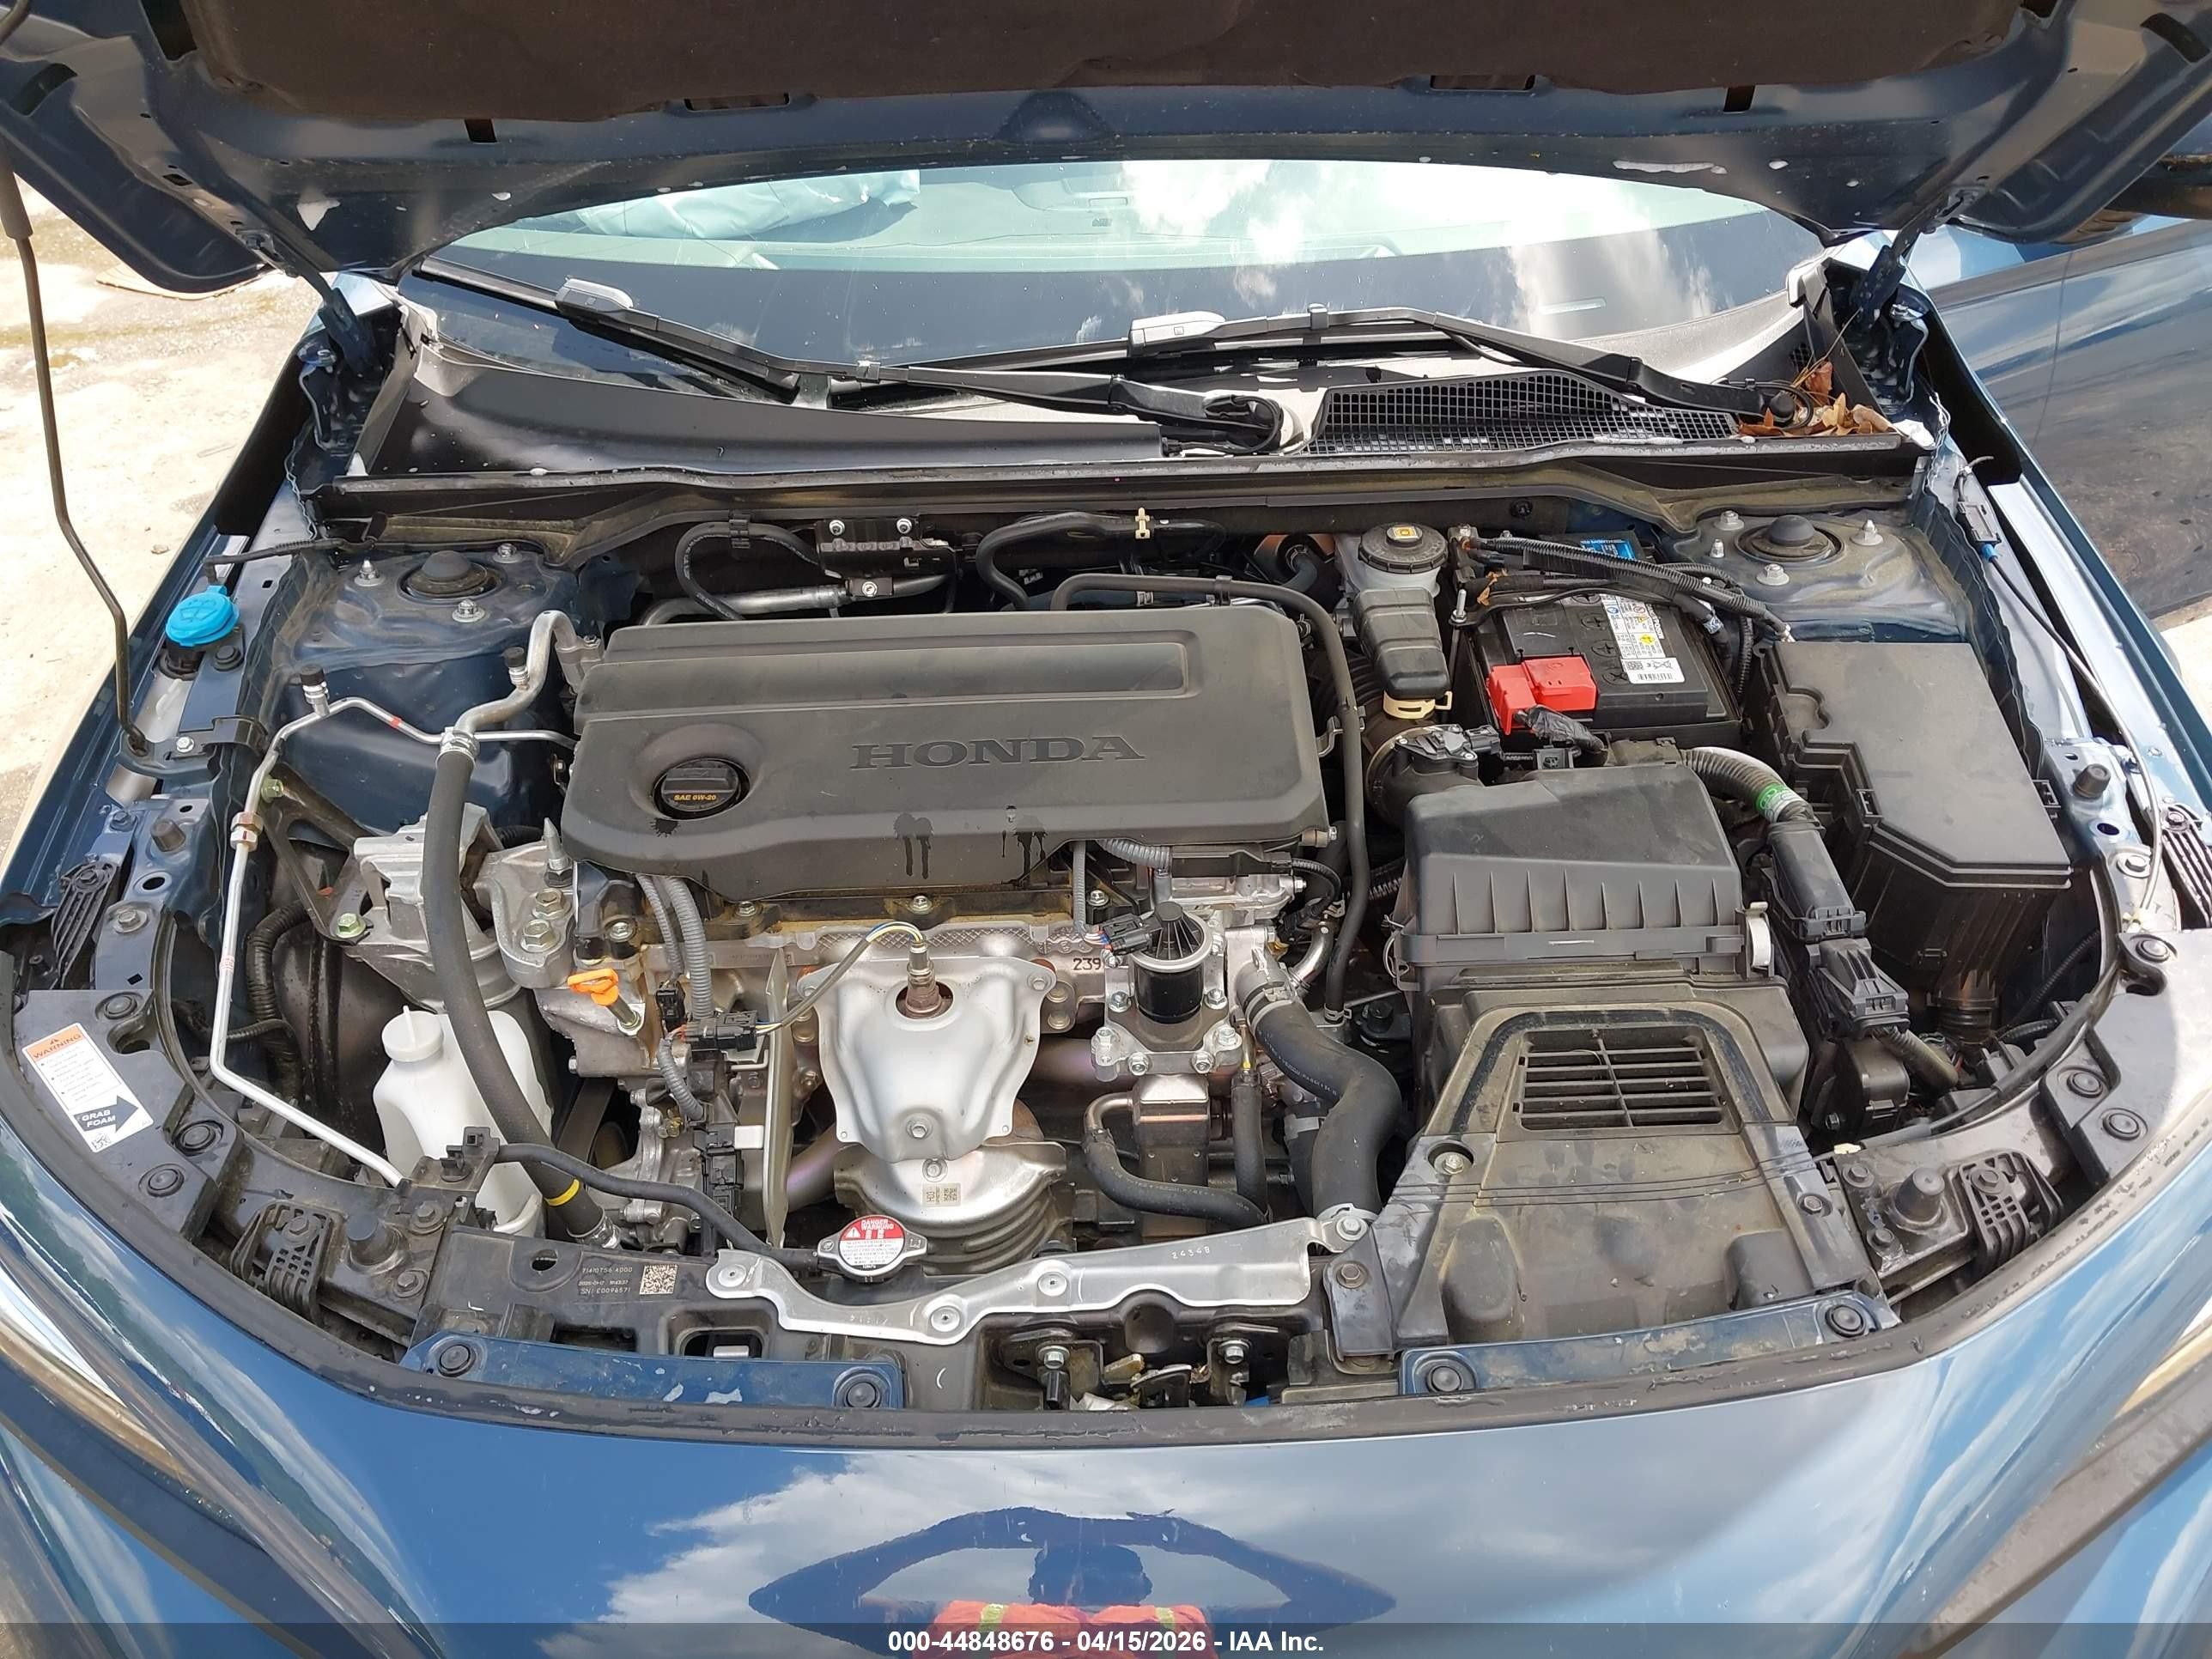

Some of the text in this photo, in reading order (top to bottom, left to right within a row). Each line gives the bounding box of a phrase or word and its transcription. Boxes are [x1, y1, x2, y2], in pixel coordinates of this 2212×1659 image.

[849, 736, 1146, 769] HONDA
[1073, 957, 1101, 970] 239
[33, 1034, 81, 1059] WARNING
[82, 1109, 111, 1121] GRAB
[87, 1115, 116, 1127] FOAM
